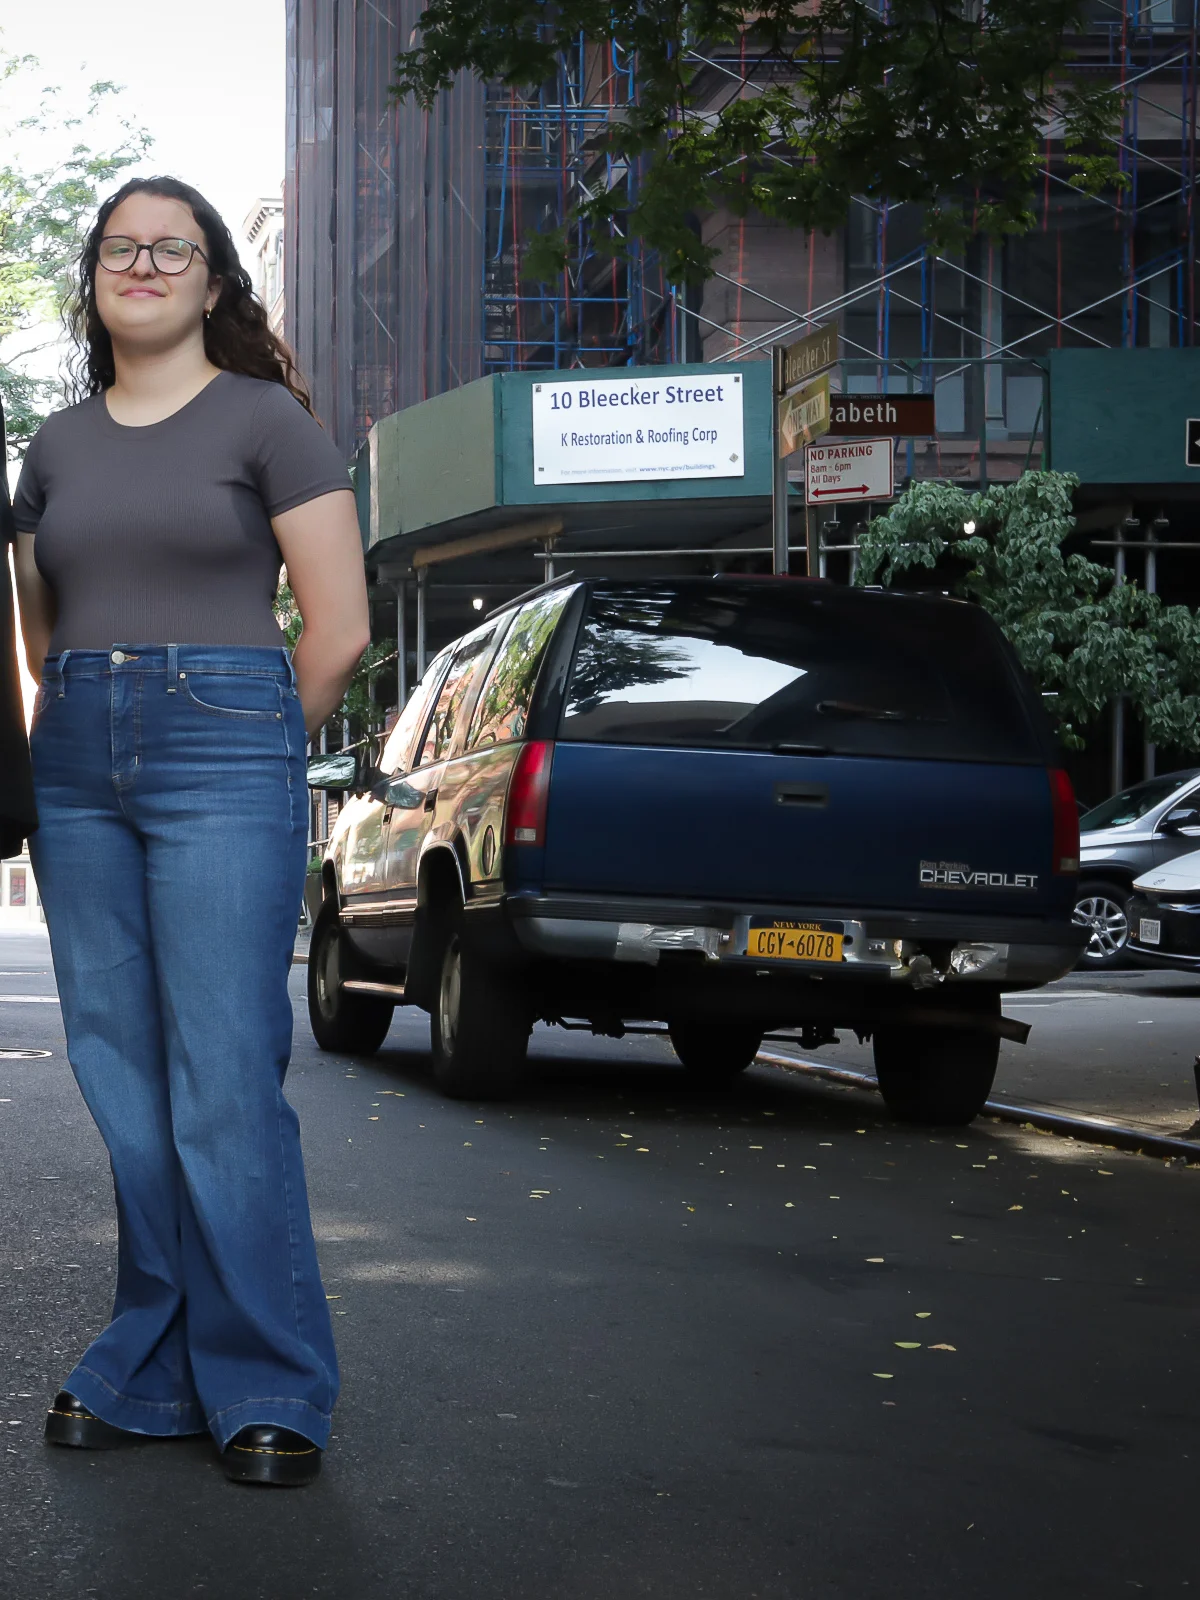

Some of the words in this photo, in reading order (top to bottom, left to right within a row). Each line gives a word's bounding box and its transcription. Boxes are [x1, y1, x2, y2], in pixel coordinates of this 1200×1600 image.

[822, 336, 831, 364] St
[550, 391, 572, 410] 10
[579, 387, 659, 408] Bleecker
[665, 385, 724, 403] Street
[788, 408, 802, 434] ONE
[806, 395, 821, 424] WAY
[561, 433, 568, 447] K
[571, 430, 632, 446] Restoration
[635, 429, 644, 444] &
[648, 428, 689, 446] Roofing
[692, 427, 718, 444] Corp
[810, 449, 825, 461] NO
[827, 445, 873, 460] PARKING
[810, 464, 827, 474] 8am
[834, 462, 852, 474] 6pm
[811, 475, 821, 485] All
[823, 473, 841, 486] Days
[939, 860, 971, 872] Perkins
[920, 869, 1039, 887] CHEVROLET
[773, 921, 796, 929] NEW
[797, 922, 822, 931] YORK
